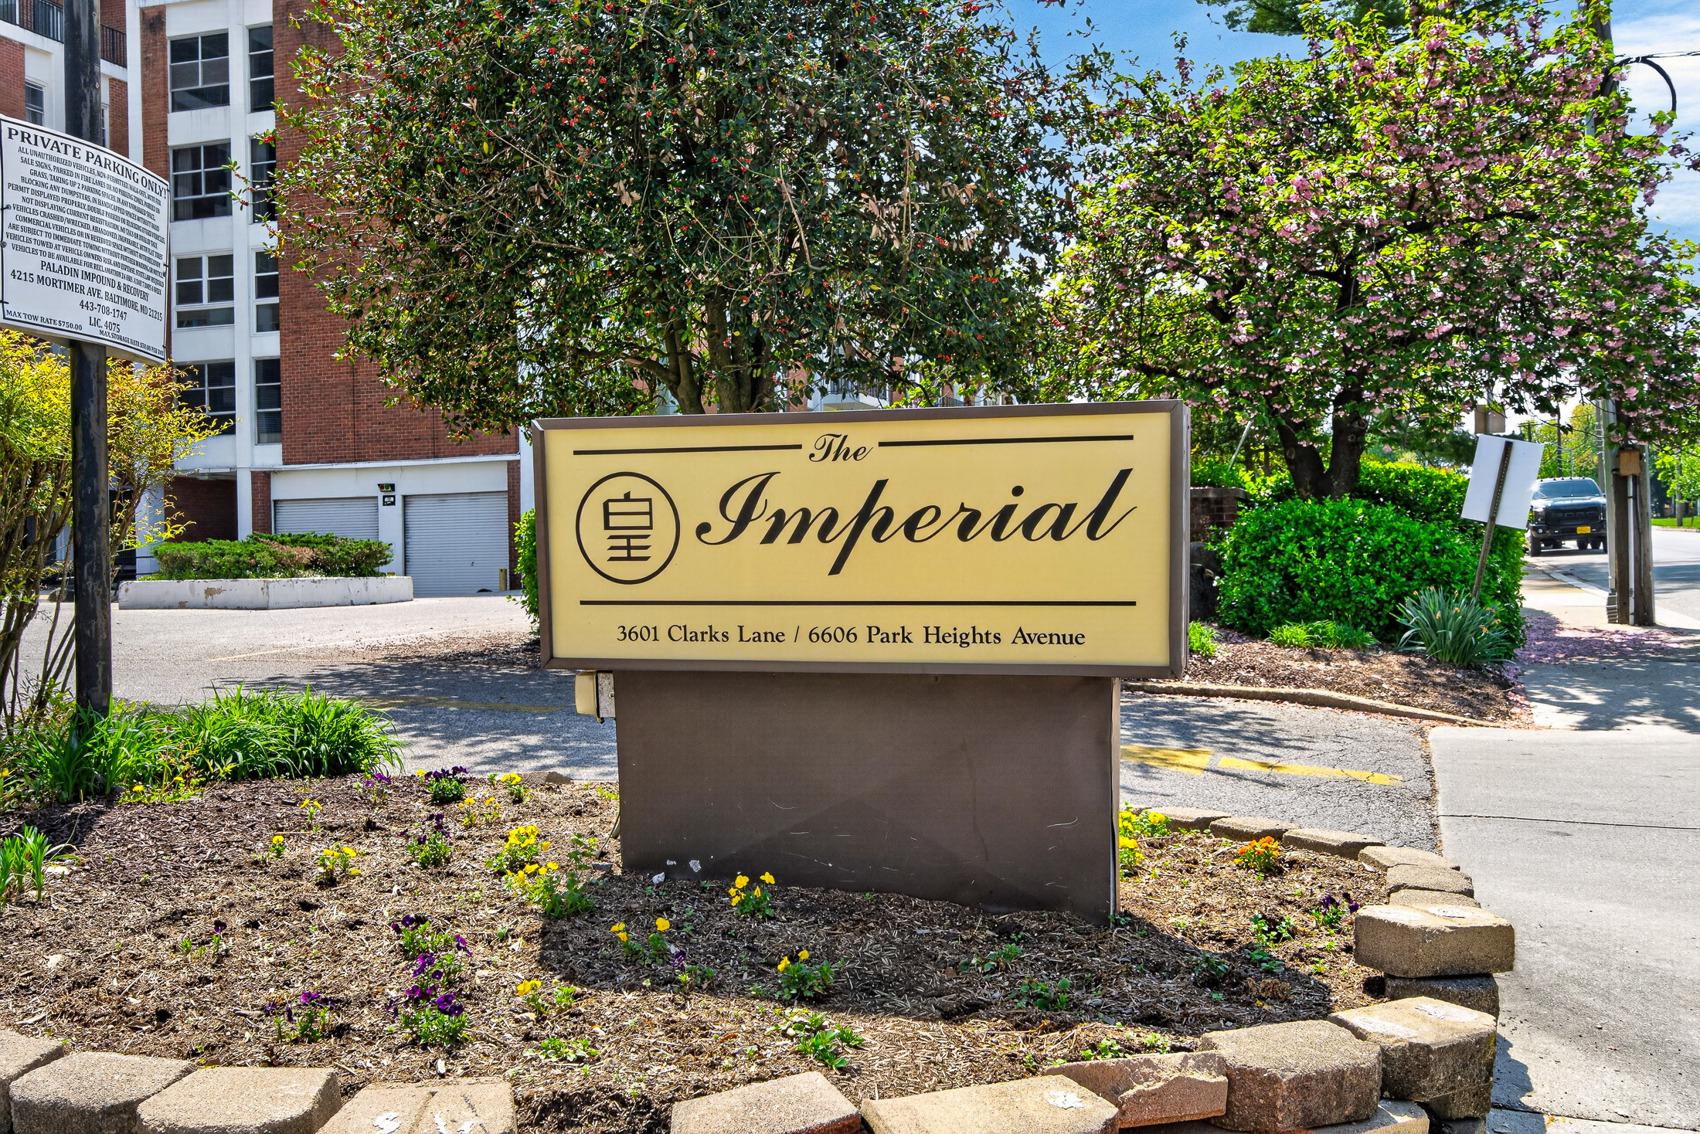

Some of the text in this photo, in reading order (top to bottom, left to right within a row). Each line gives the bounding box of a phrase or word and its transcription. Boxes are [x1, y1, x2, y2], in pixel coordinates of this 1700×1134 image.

[8, 126, 166, 200] PRIVATE PARKING ONLY!
[18, 146, 29, 155] ALL
[30, 149, 72, 168] UNAUTHORIZED
[21, 156, 34, 166] SALE
[35, 160, 52, 171] SIGNS,
[53, 165, 73, 178] PARKED
[75, 172, 79, 180] IN
[81, 174, 91, 183] FIRE
[91, 177, 106, 189] LANES
[30, 168, 48, 180] GRASS,
[49, 174, 68, 186] TAKING
[70, 180, 76, 188] UP
[82, 183, 101, 196] PARKING
[8, 182, 29, 195] PERMIT
[31, 188, 60, 203] DISPLAYED
[61, 196, 86, 210] PROPERLY,
[88, 205, 104, 216] DOUBLE
[21, 176, 48, 190] BLOCKING
[50, 184, 60, 193] ANY
[62, 187, 91, 203] DUMPSTERS,
[13, 203, 38, 216] VEHICLES
[22, 196, 34, 205] NOT
[35, 199, 65, 214] DISPLAYING
[67, 208, 89, 220] CURRENT
[8, 222, 19, 231] ARE
[21, 225, 43, 237] SUBJECT
[45, 231, 52, 239] TO
[53, 233, 81, 247] IMMEDIATE
[83, 241, 101, 253] TOWING
[102, 247, 119, 259] WITHOUT
[16, 214, 52, 229] COMMERCIAL
[52, 223, 76, 236] VEHICLES
[77, 230, 84, 238] OR
[85, 232, 90, 240] IN
[6, 231, 32, 244] VEHICLES
[33, 238, 53, 249] TOWED
[54, 243, 61, 251] AT
[62, 245, 82, 257] VEHICLE
[83, 251, 102, 262] OWNERS
[12, 243, 38, 255] VEHICLES
[39, 249, 47, 257] TO
[48, 251, 55, 259] BE
[56, 253, 82, 266] AVAILABLE
[84, 260, 93, 269] FOR
[94, 263, 120, 278] RECLAMATION
[10, 268, 162, 322] 4215 MORTIMER AVE. BALTIMORE, MD 21215
[41, 260, 149, 302] PALADIN IMPOUND & RECOVERY
[6, 309, 82, 332] MAX TOW RATE $750.00
[79, 299, 127, 321] 443-708-1747
[89, 316, 120, 334] LIC. 4075
[111, 333, 129, 344] STORAGE
[809, 433, 873, 462] The
[602, 491, 653, 562] 皇
[695, 467, 1138, 576] Imperial
[616, 625, 1085, 649] 3601 Clarks Lane / 6606 Park Heights Avenue
